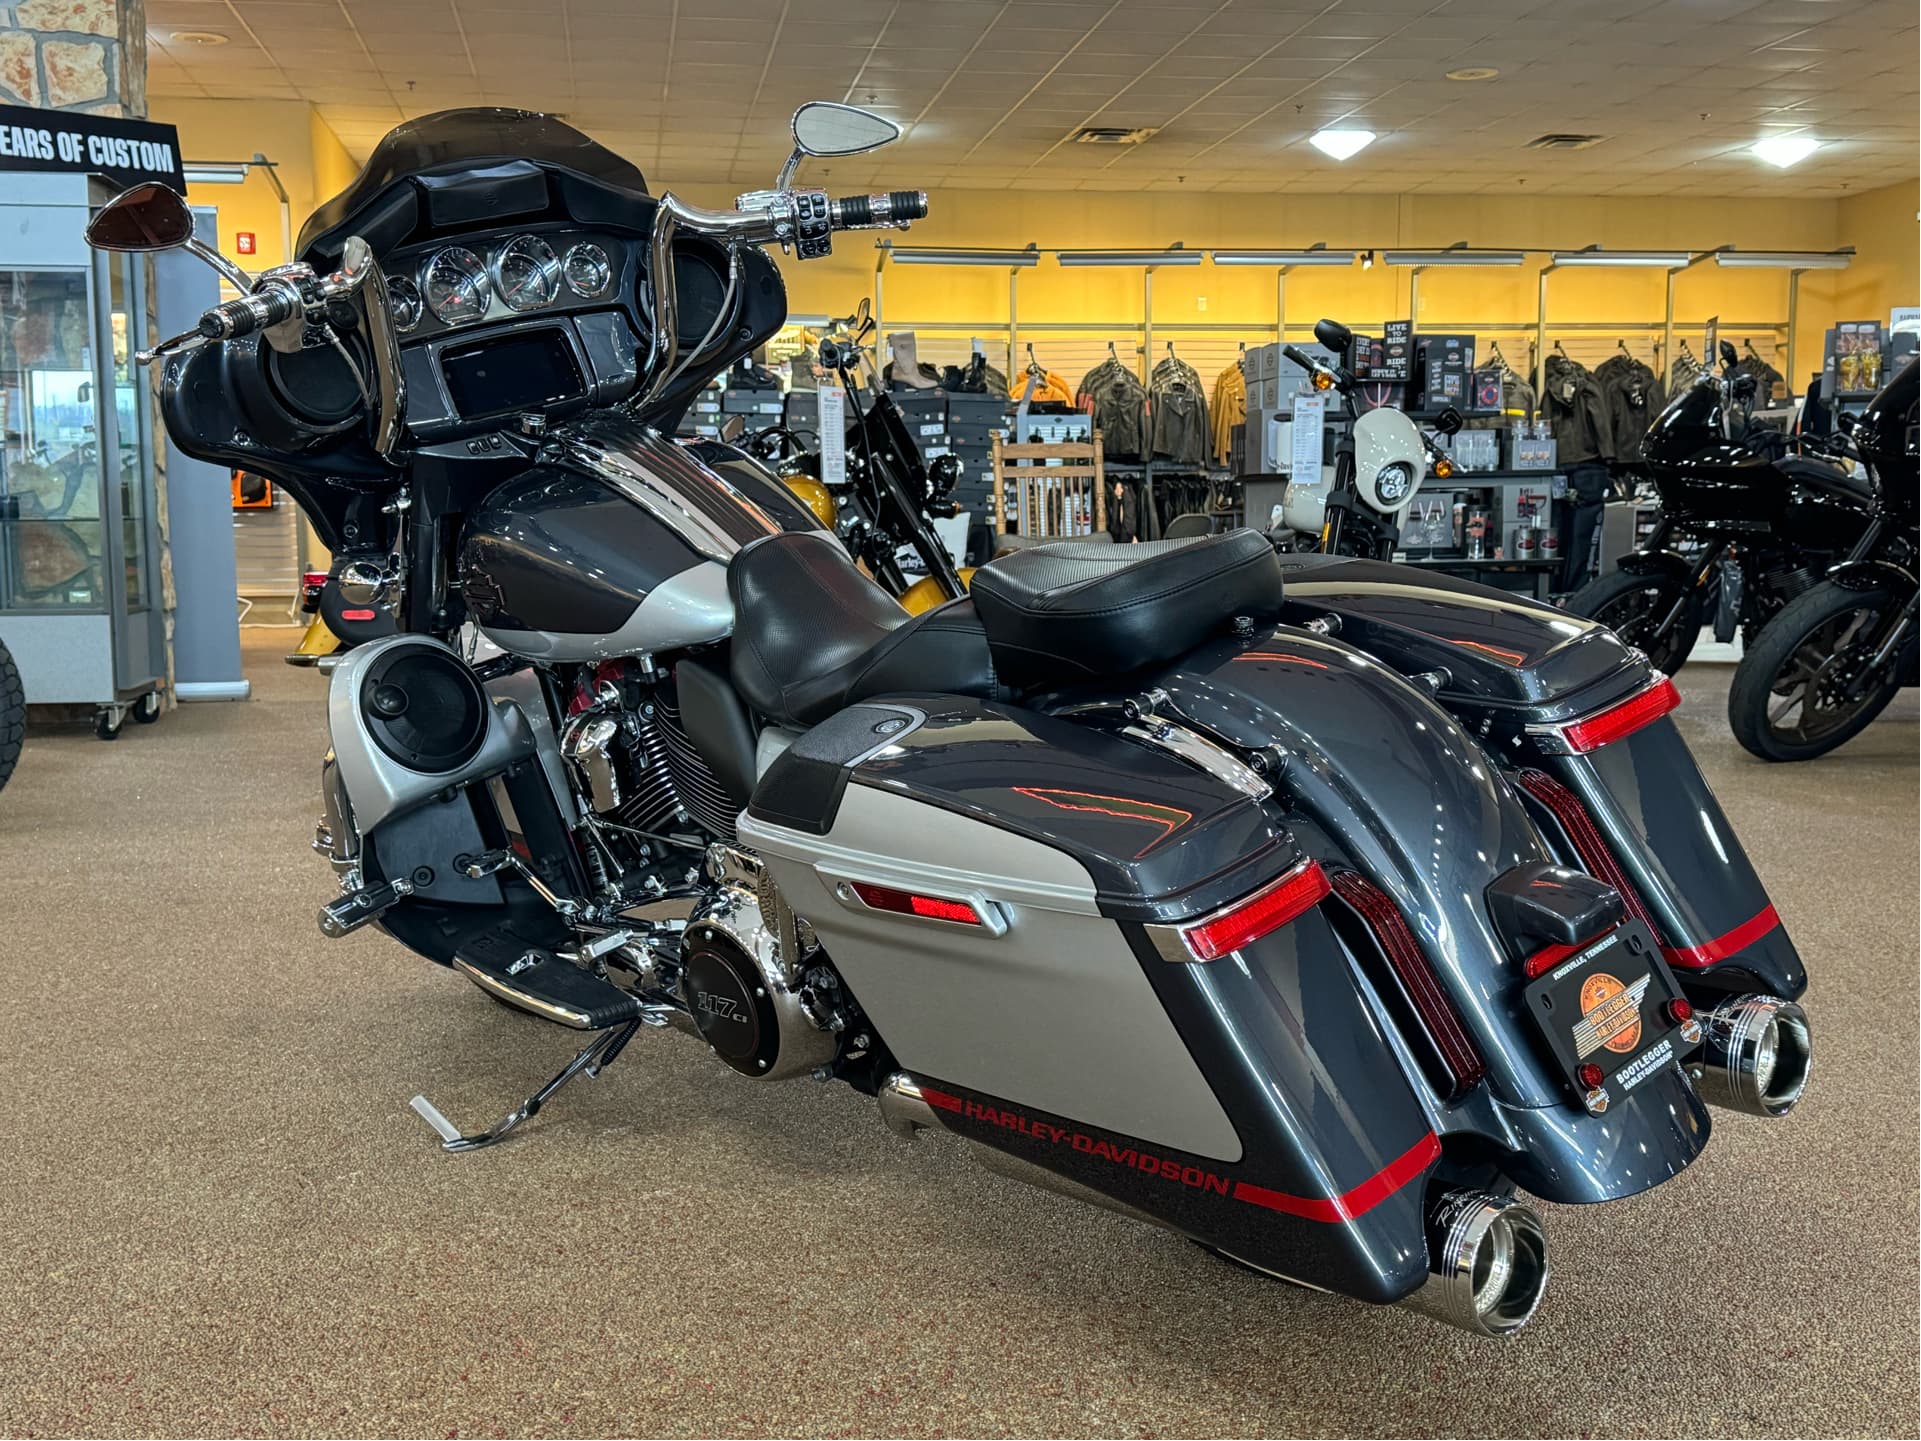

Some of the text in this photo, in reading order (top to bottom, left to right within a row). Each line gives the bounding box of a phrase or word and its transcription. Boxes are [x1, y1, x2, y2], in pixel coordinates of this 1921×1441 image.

[56, 131, 85, 163] OF
[87, 135, 175, 173] CUSTOM
[1387, 323, 1407, 332] LIVE
[1387, 336, 1407, 344] RIDE
[1386, 357, 1407, 366] RIDE
[1552, 934, 1618, 981] KNOXVILLE, TENNESSEE
[1589, 993, 1630, 1026] BOOTLEGGER
[1615, 1039, 1672, 1084] BOOTLEGGER
[965, 1099, 1230, 1197] HARLEY-DAVIDSON
